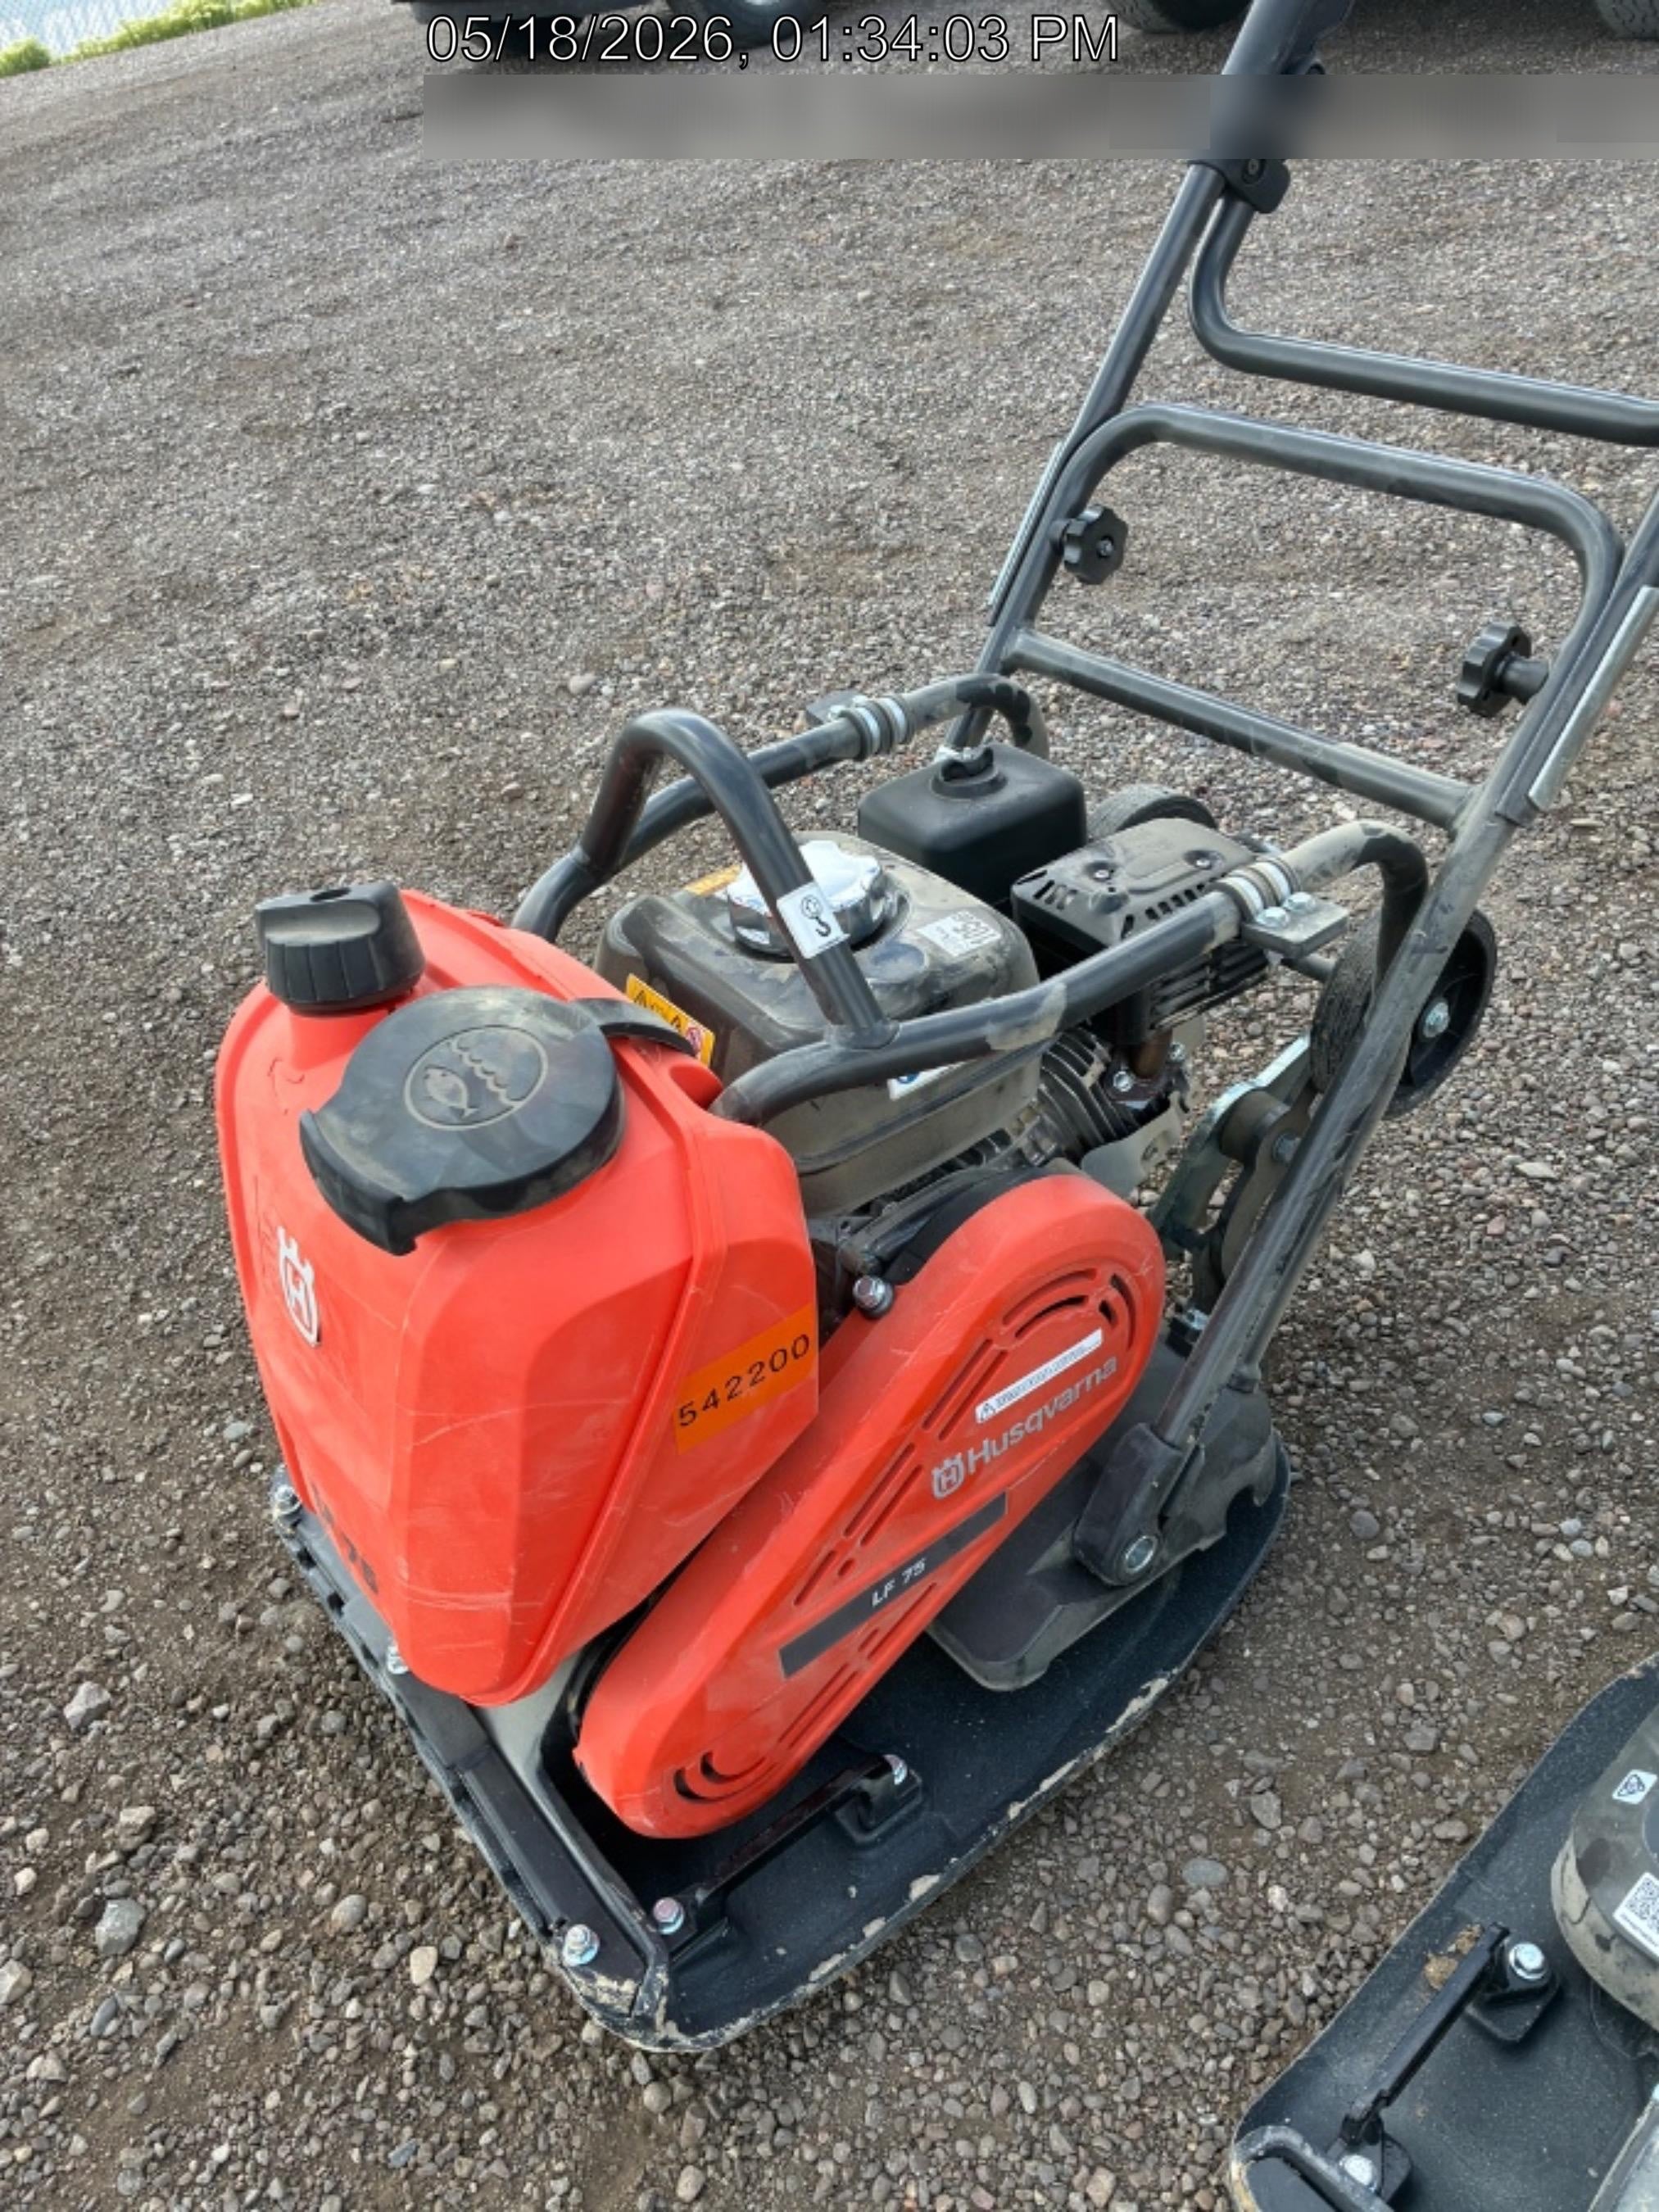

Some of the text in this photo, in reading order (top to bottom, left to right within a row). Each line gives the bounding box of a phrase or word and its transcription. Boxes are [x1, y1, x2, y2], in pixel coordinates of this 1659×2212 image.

[679, 1333, 809, 1426] 542200
[967, 1356, 1117, 1474] Husqvarna
[872, 1557, 926, 1607] LF 75
